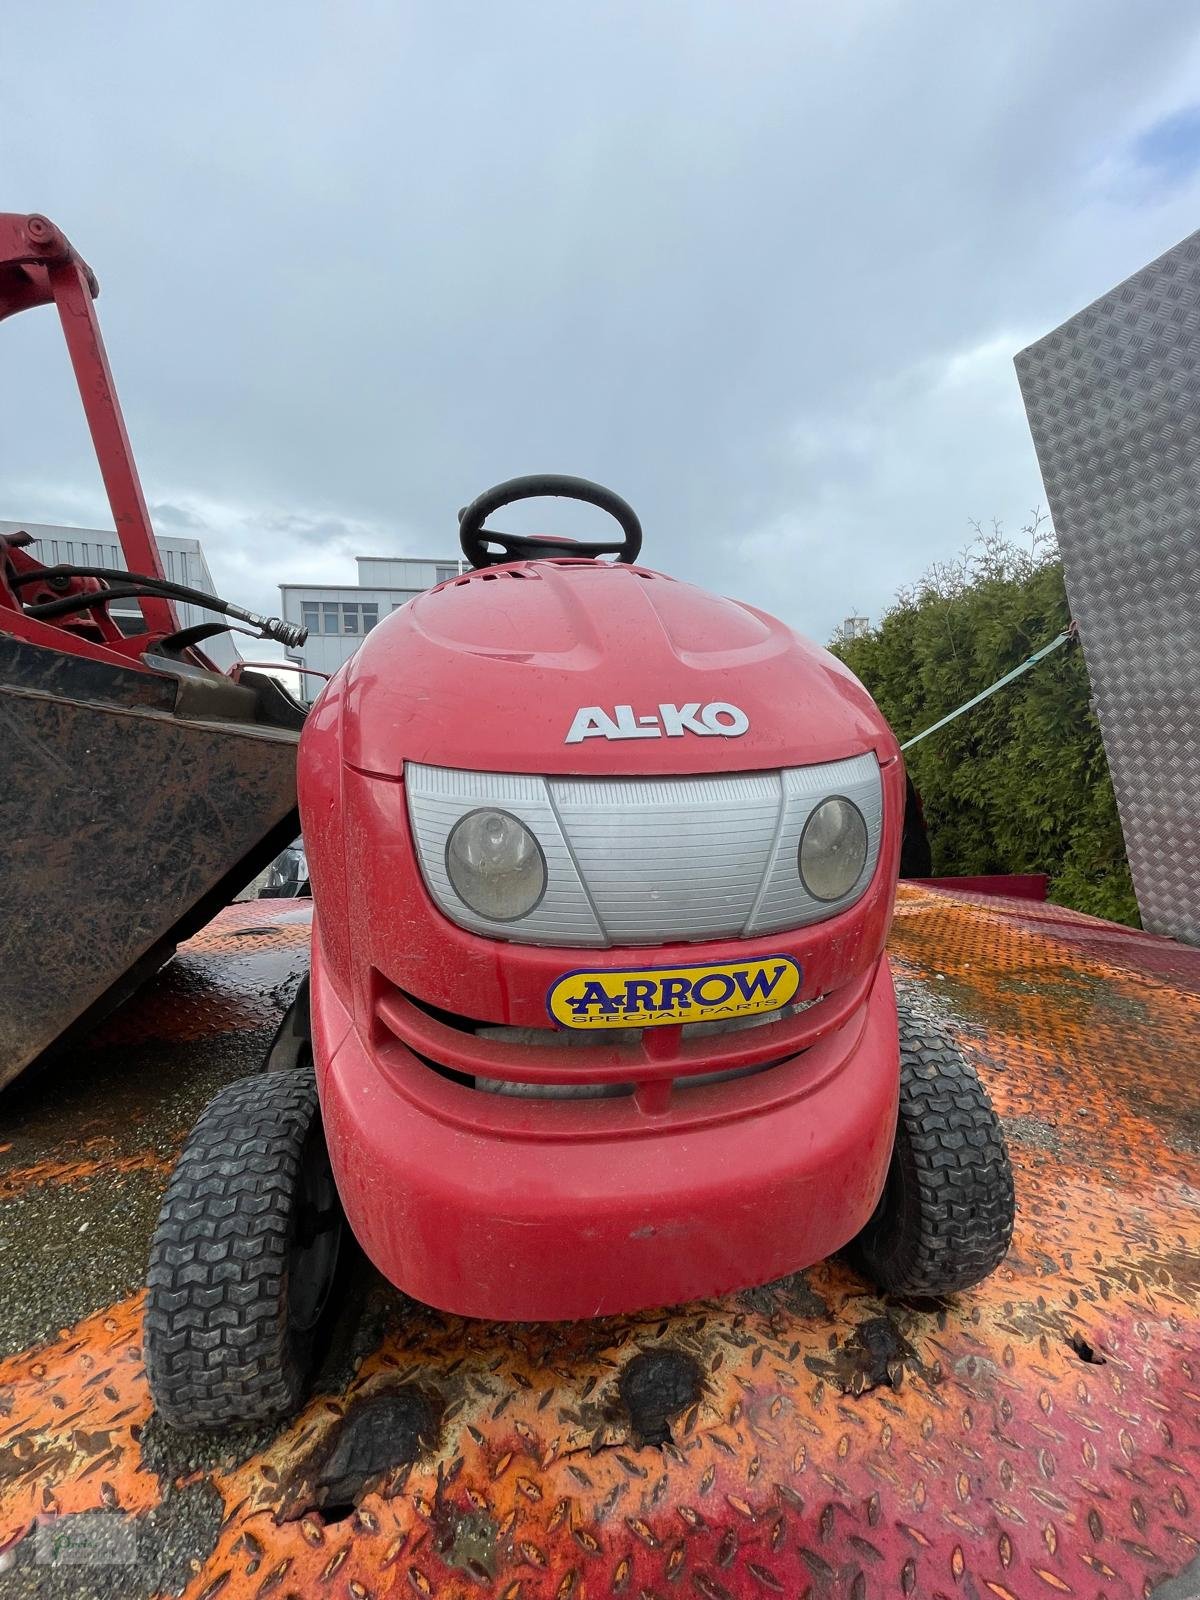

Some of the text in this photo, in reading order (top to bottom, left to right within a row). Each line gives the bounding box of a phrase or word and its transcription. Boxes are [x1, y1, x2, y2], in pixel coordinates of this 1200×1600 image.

[564, 702, 749, 744] AL-KO
[566, 966, 787, 1015] ARROW
[572, 998, 778, 1023] SPECIAL PARTS
